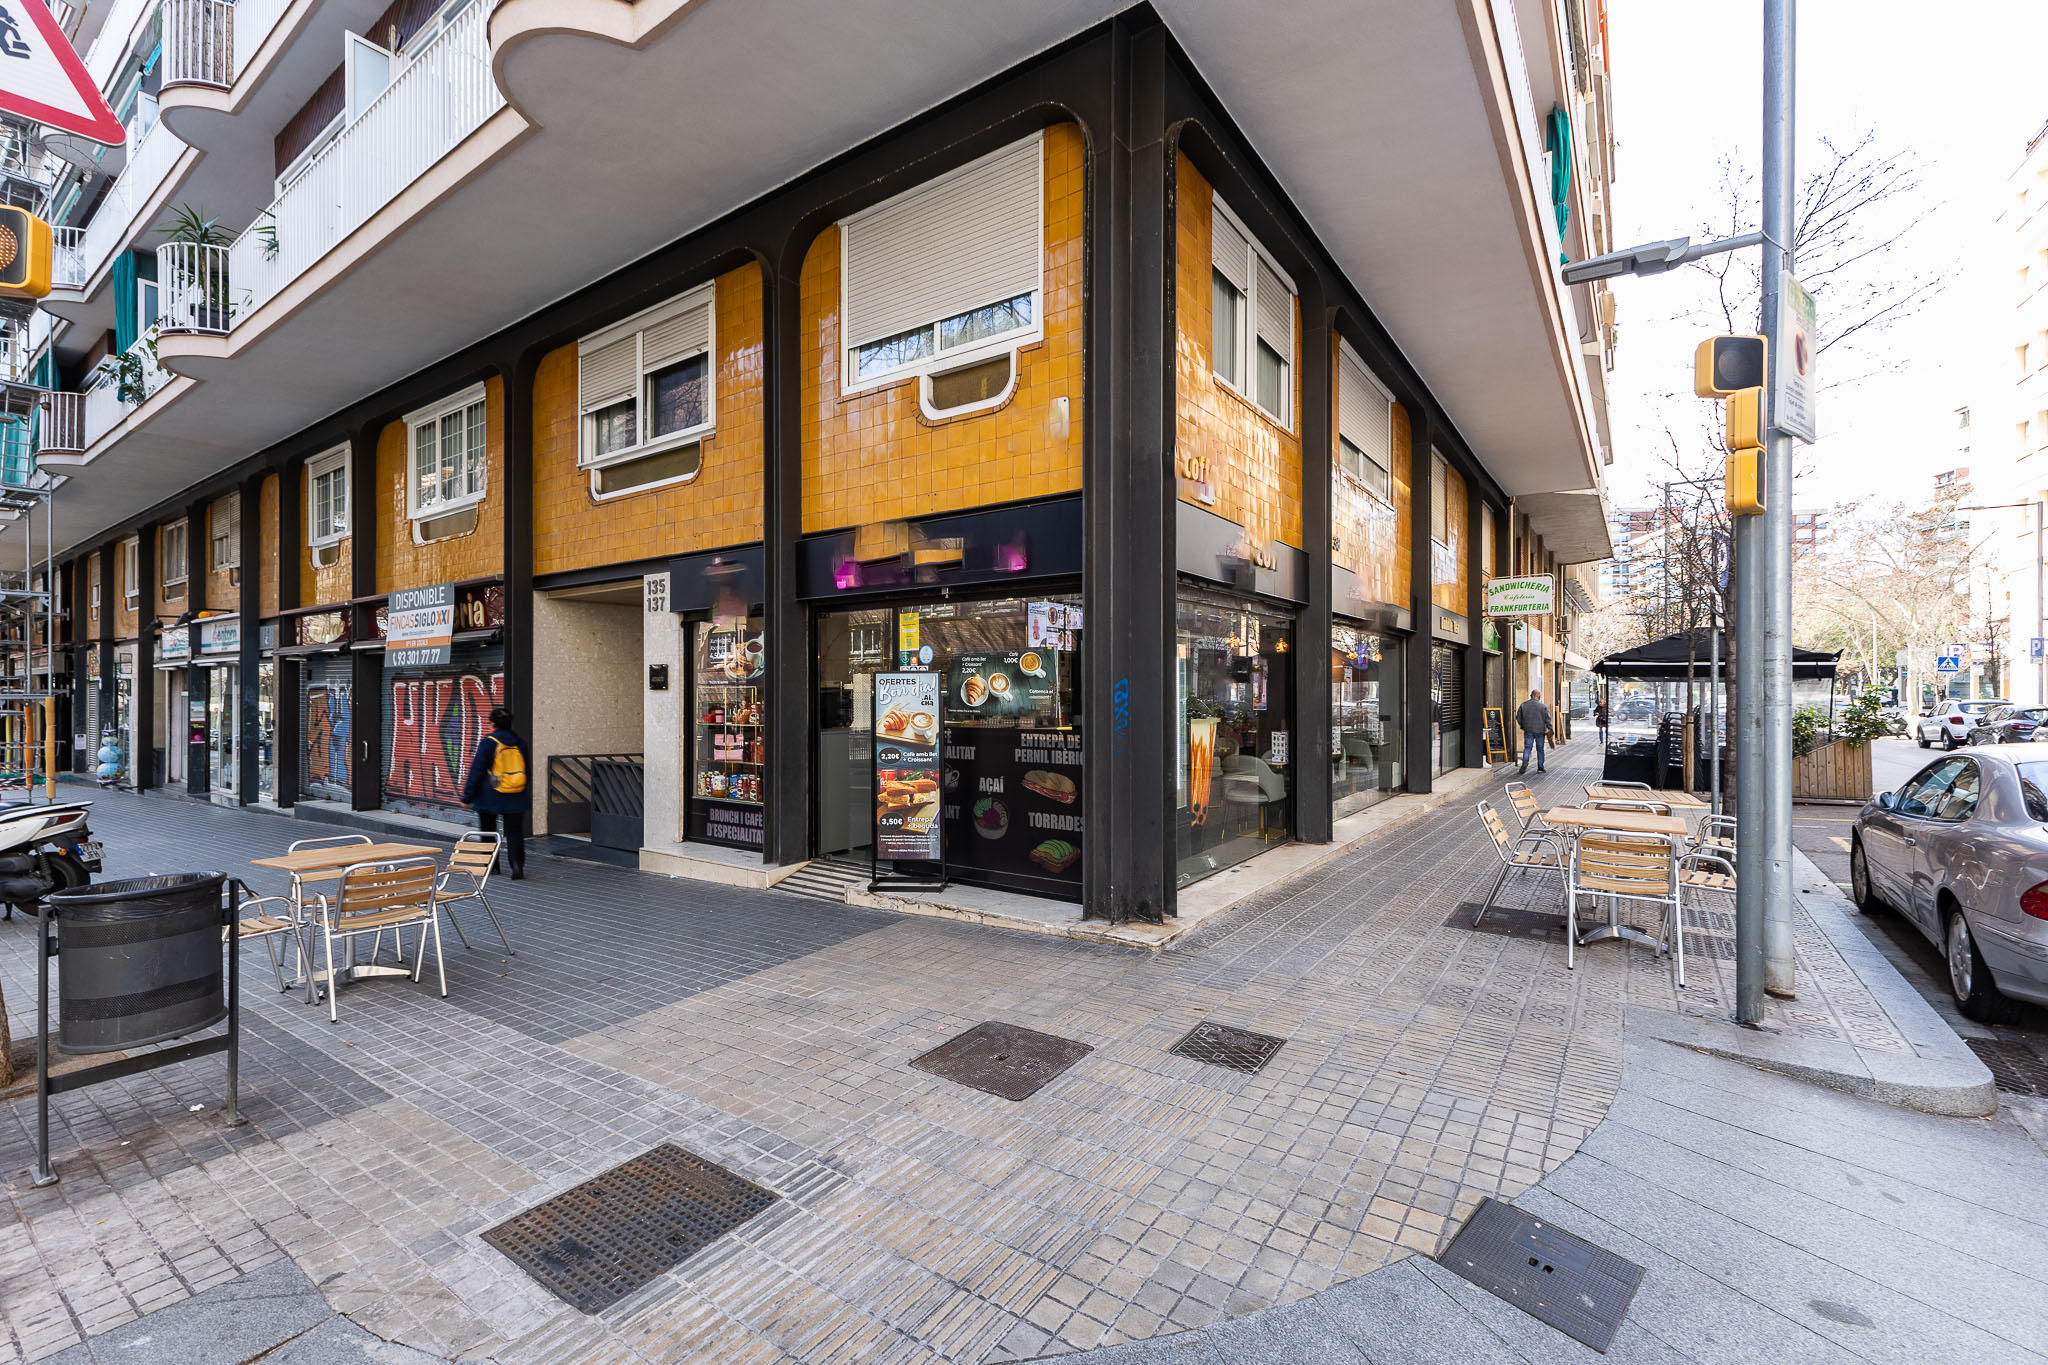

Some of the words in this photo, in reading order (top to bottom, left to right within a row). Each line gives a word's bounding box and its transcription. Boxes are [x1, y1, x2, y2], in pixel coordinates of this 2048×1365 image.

[646, 579, 666, 595] 135
[1488, 581, 1551, 597] SANDWICHERIA
[395, 586, 446, 610] DISPONIBLE
[646, 596, 666, 612] 137
[1489, 603, 1550, 613] FRANKFURTERIA
[2032, 640, 2041, 656] P
[397, 652, 406, 665] 93
[407, 651, 419, 664] 301
[421, 650, 430, 663] 77
[431, 649, 441, 663] 77
[878, 678, 917, 686] OFERTES
[879, 681, 909, 705] Bon
[1020, 732, 1065, 748] ENTREPÀ
[1067, 734, 1081, 749] DE
[1014, 748, 1050, 764] PERNIL
[978, 776, 1005, 794] AÇAÍ
[709, 808, 740, 824] BRUNCH
[740, 812, 744, 824] I
[744, 811, 763, 827] CAFÈ
[881, 818, 903, 826] 3,50€
